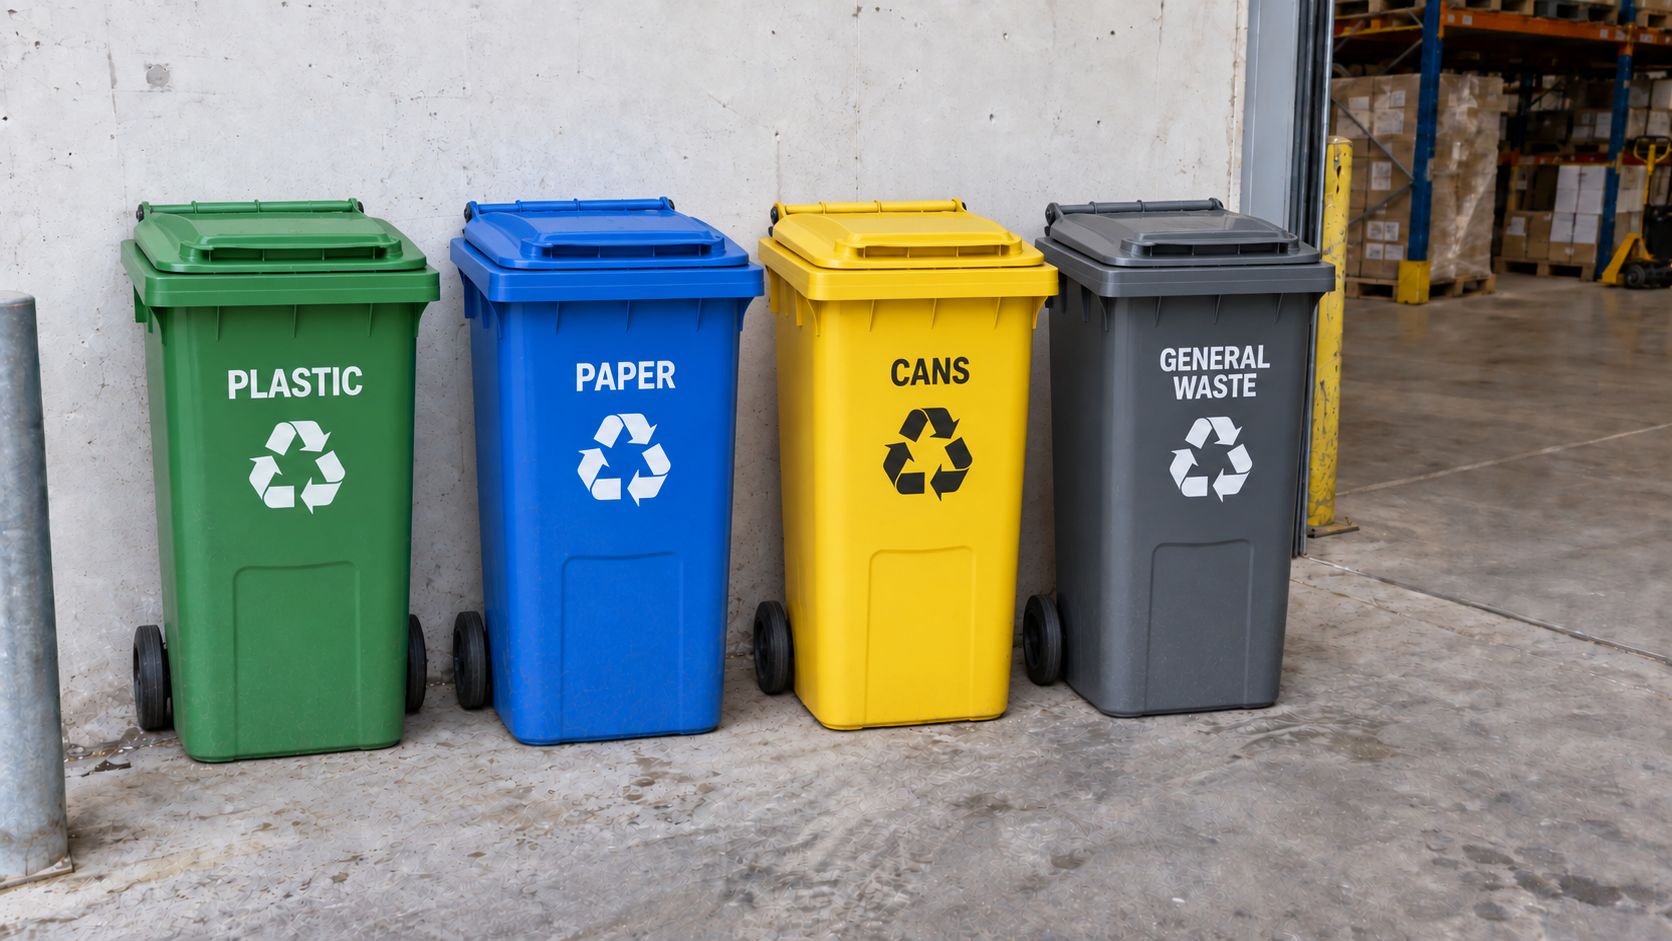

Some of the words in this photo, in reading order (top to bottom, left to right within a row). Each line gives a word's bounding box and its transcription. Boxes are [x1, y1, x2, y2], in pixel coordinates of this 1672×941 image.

[891, 356, 970, 387] CANS
[1160, 345, 1270, 372] GENERAL
[227, 366, 363, 400] PLASTIC
[576, 361, 676, 392] PAPER
[1173, 373, 1257, 400] WASTE
